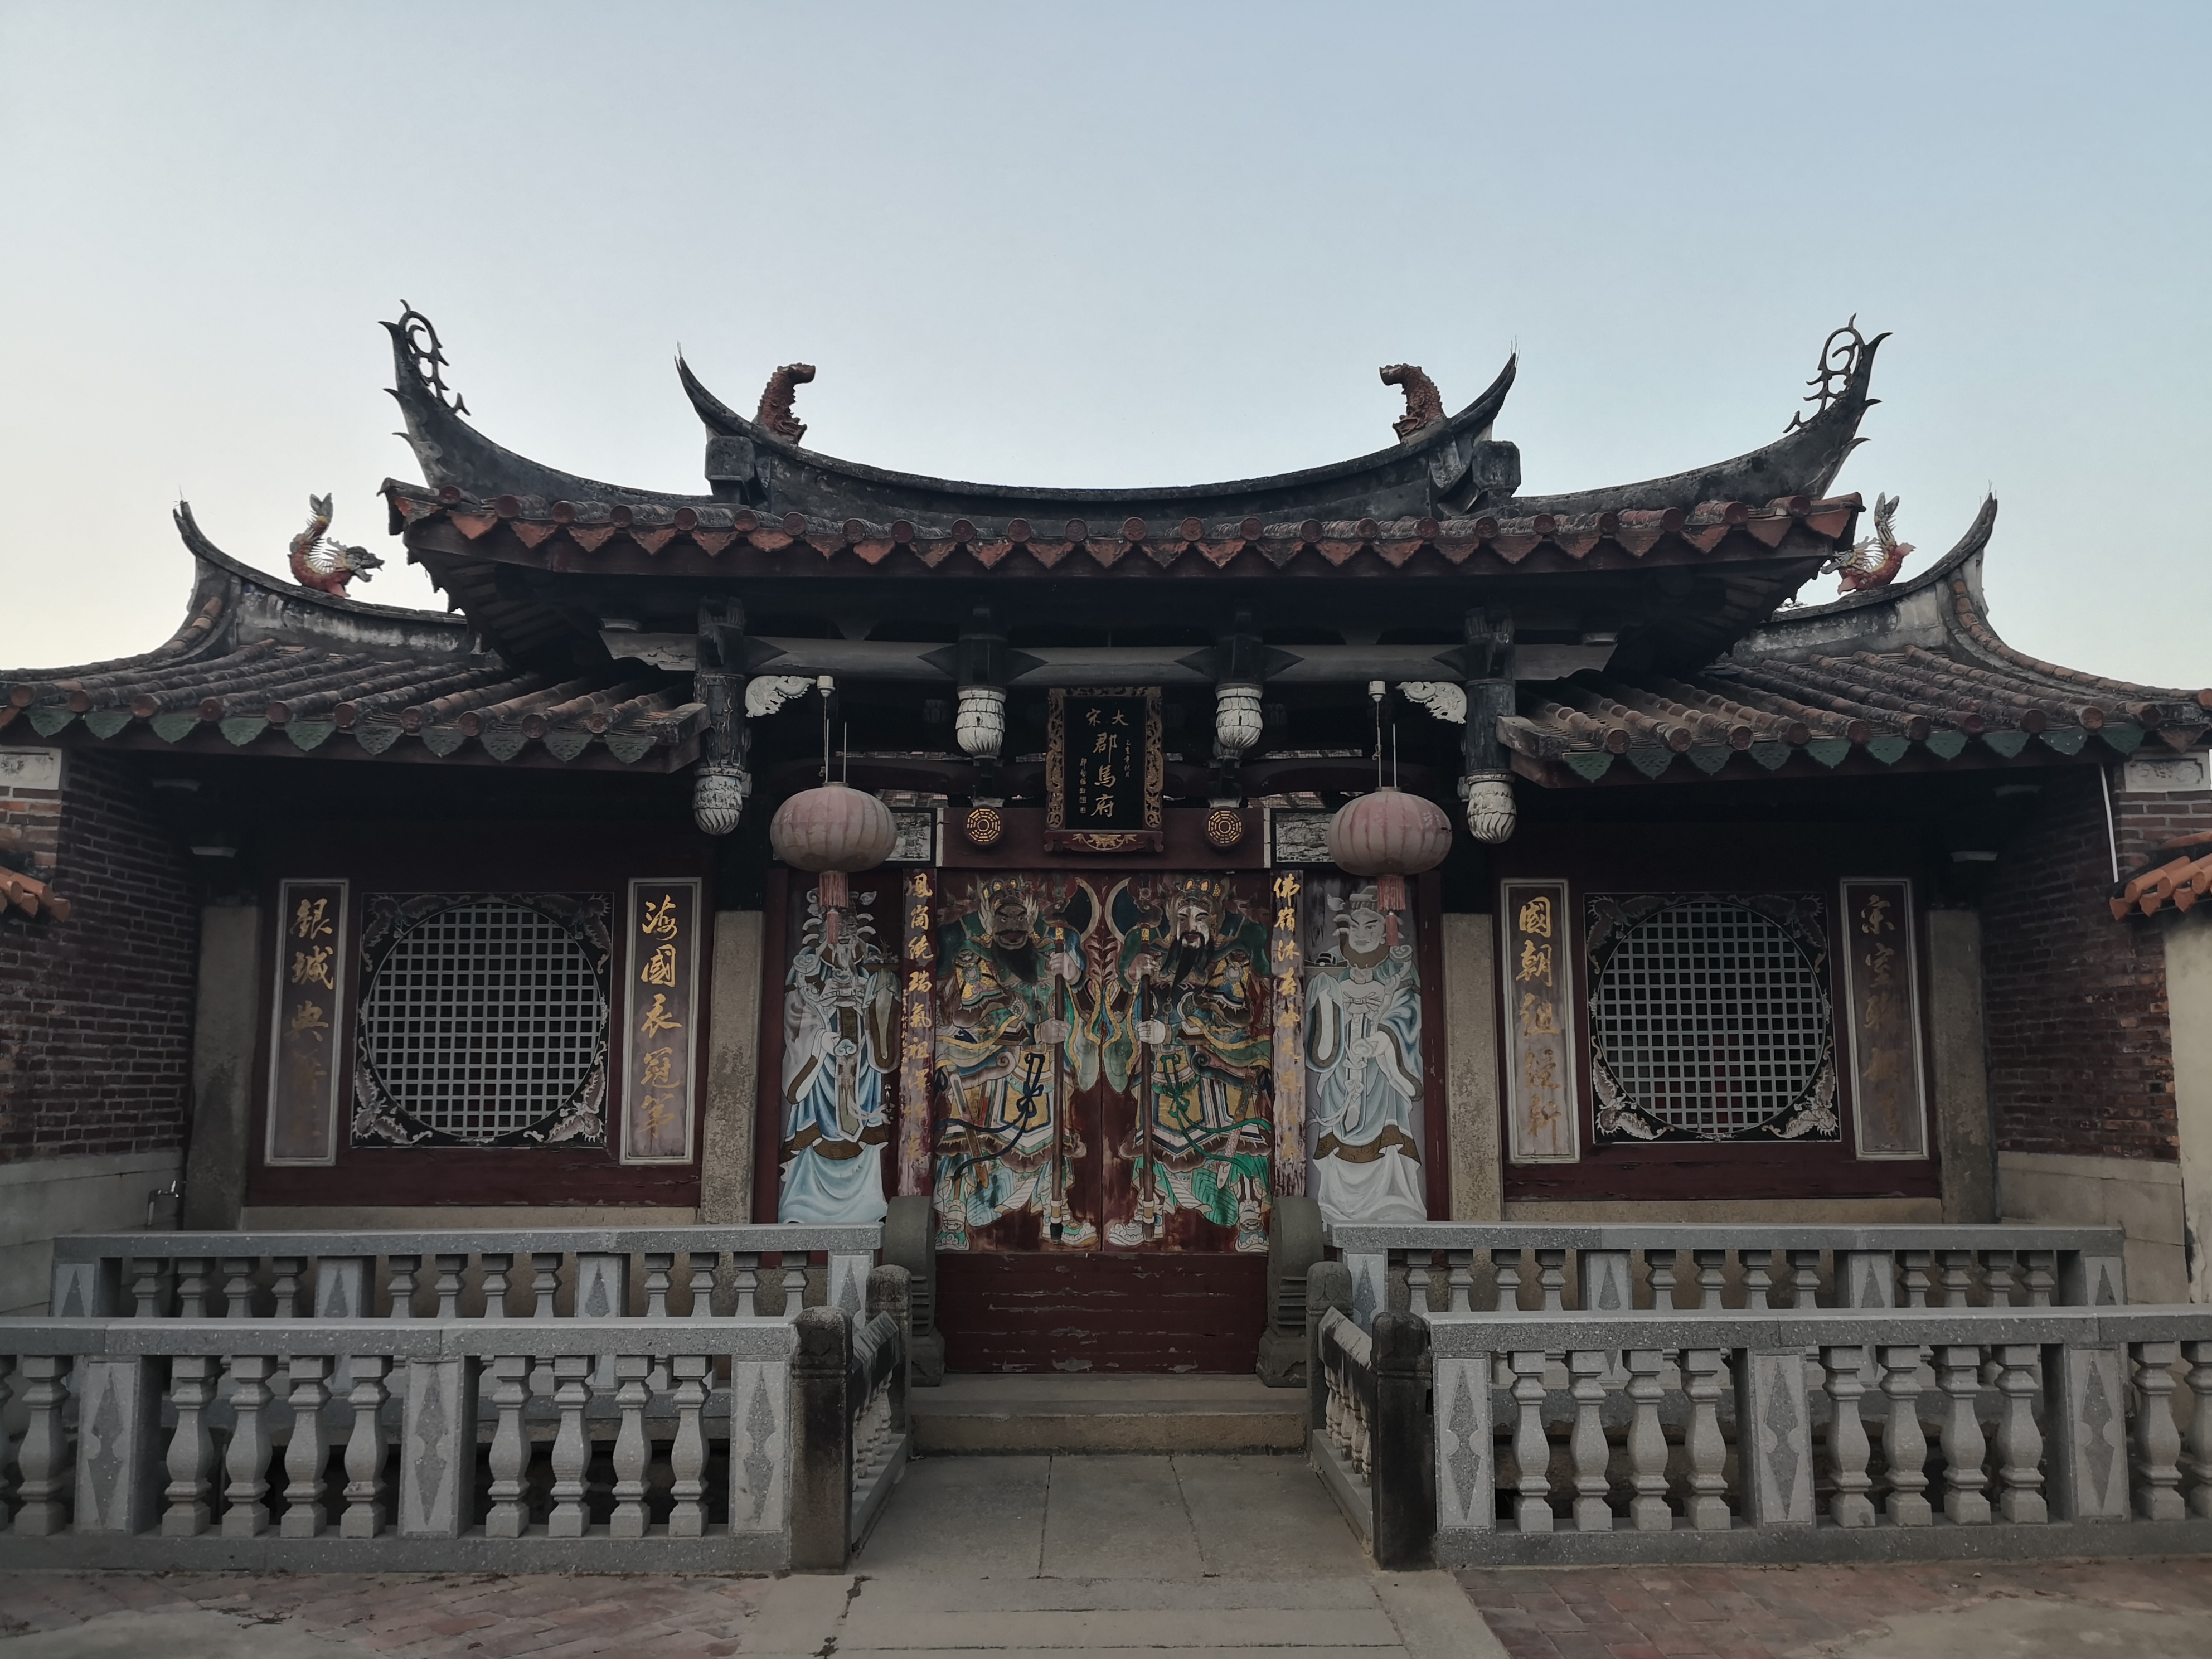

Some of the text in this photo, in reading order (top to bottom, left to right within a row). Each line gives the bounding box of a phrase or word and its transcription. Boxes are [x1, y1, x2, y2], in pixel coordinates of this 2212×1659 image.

[1091, 733, 1118, 817] 郡馬府
[641, 895, 682, 1138] 海國衣冠第
